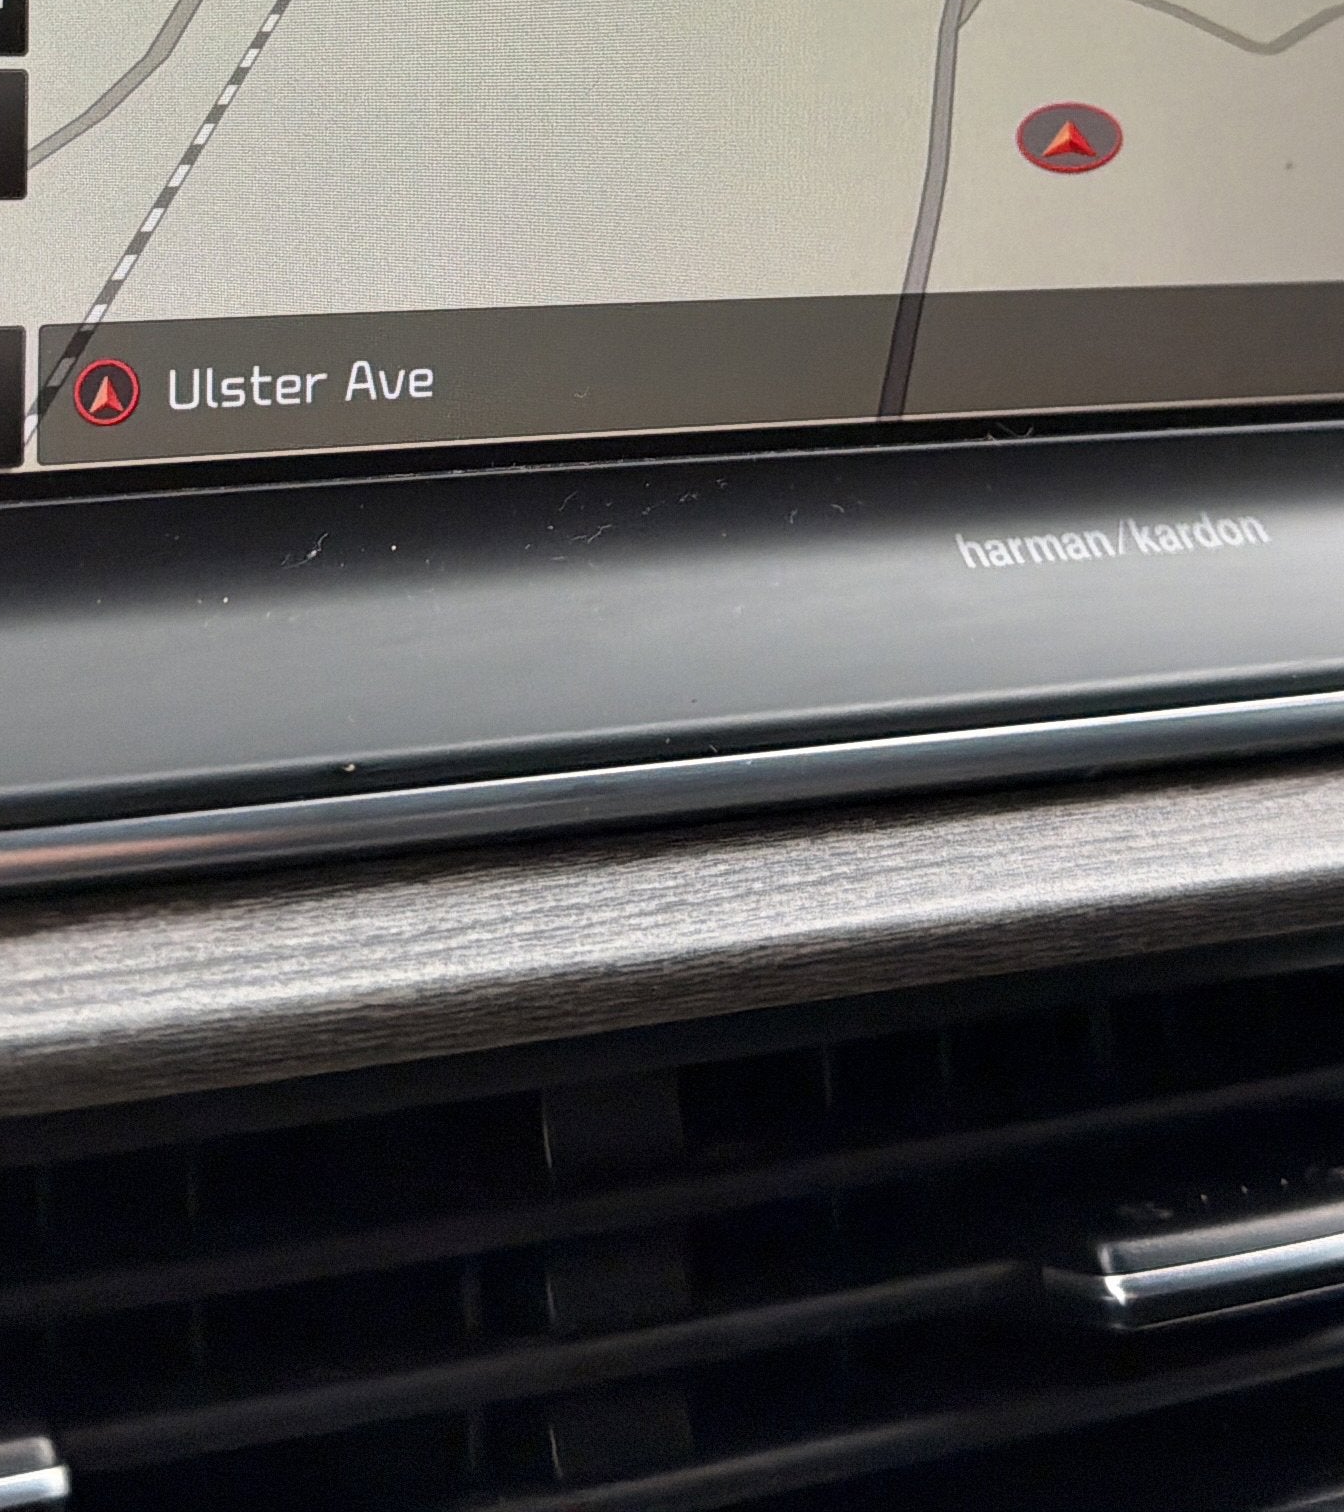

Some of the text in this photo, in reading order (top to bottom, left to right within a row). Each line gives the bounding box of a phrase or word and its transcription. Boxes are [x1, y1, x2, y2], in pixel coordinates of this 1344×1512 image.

[168, 360, 436, 410] Ulster Ave
[956, 513, 1271, 569] harman/kardon
